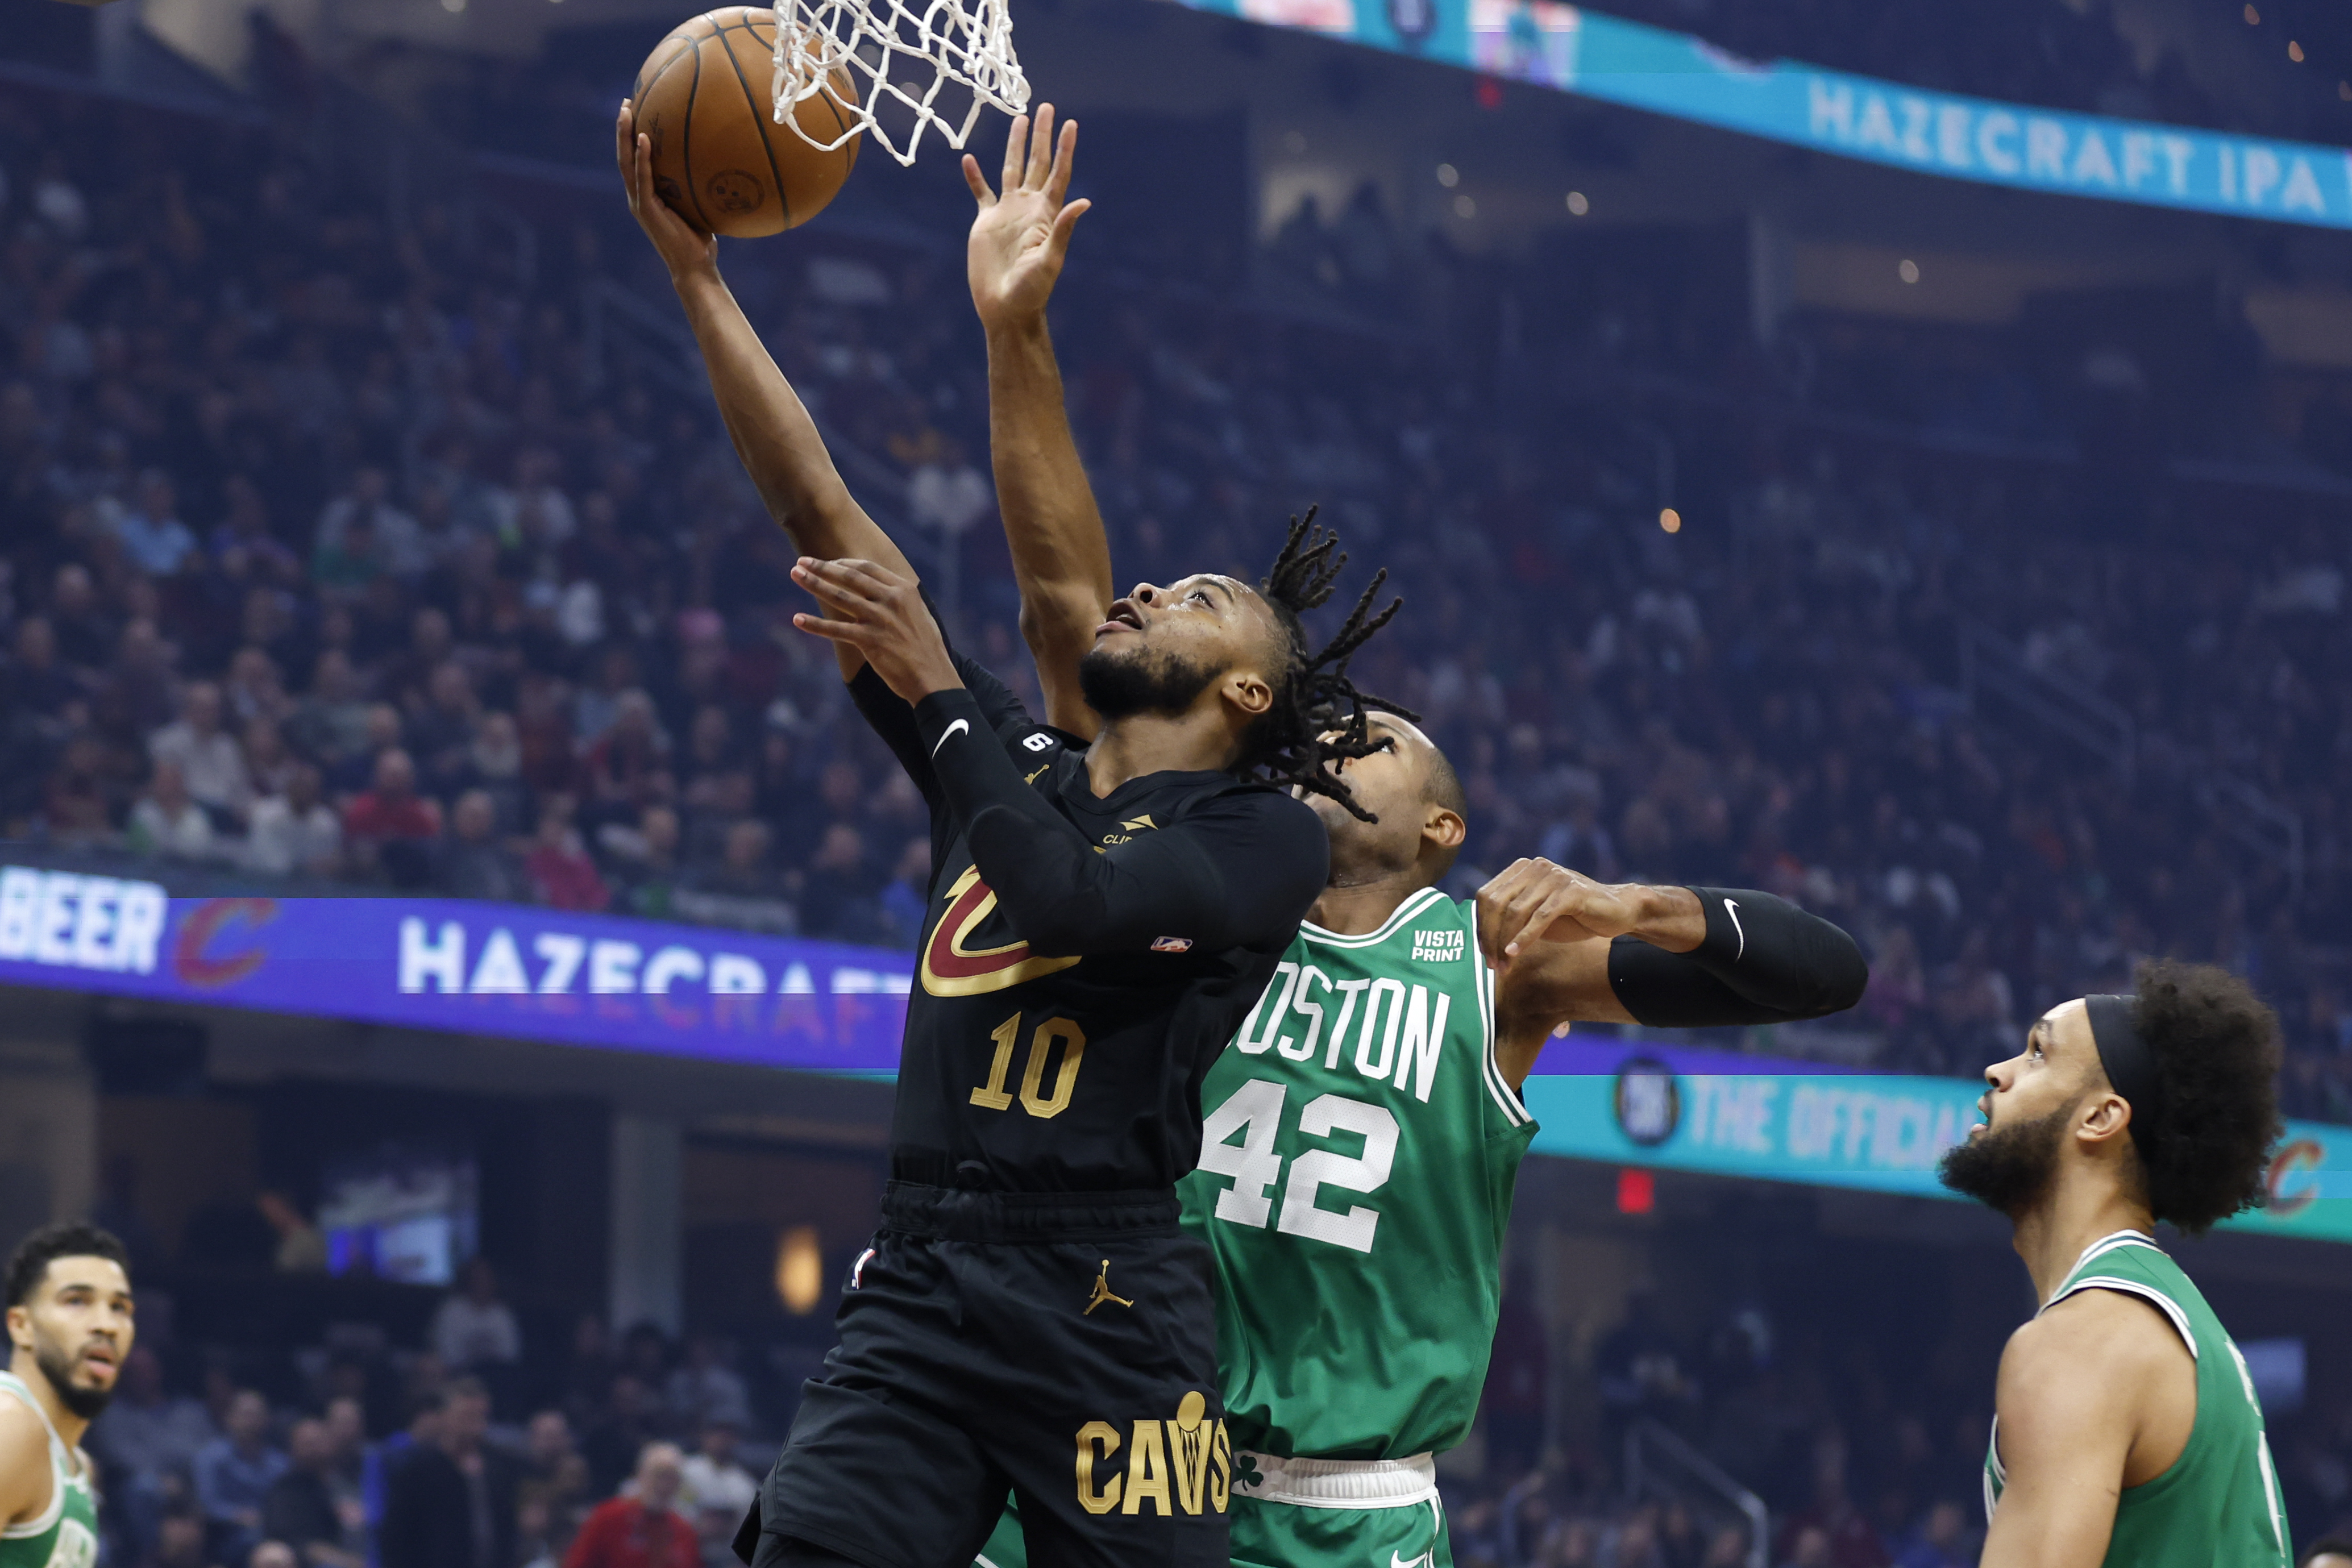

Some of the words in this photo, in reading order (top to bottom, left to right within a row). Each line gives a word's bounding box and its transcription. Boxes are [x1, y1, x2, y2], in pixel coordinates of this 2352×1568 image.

[1807, 78, 2195, 196] HAZECRAFT
[2217, 140, 2326, 215] IPA
[1023, 733, 1053, 751] 6
[0, 865, 168, 975] BEER
[1411, 947, 1464, 962] PRINT
[1415, 930, 1464, 947] VISTA
[969, 1011, 1087, 1119] 10
[1225, 961, 1451, 1104] OSTON
[1196, 1079, 1401, 1254] 42
[1075, 1418, 1231, 1516] CAVS
